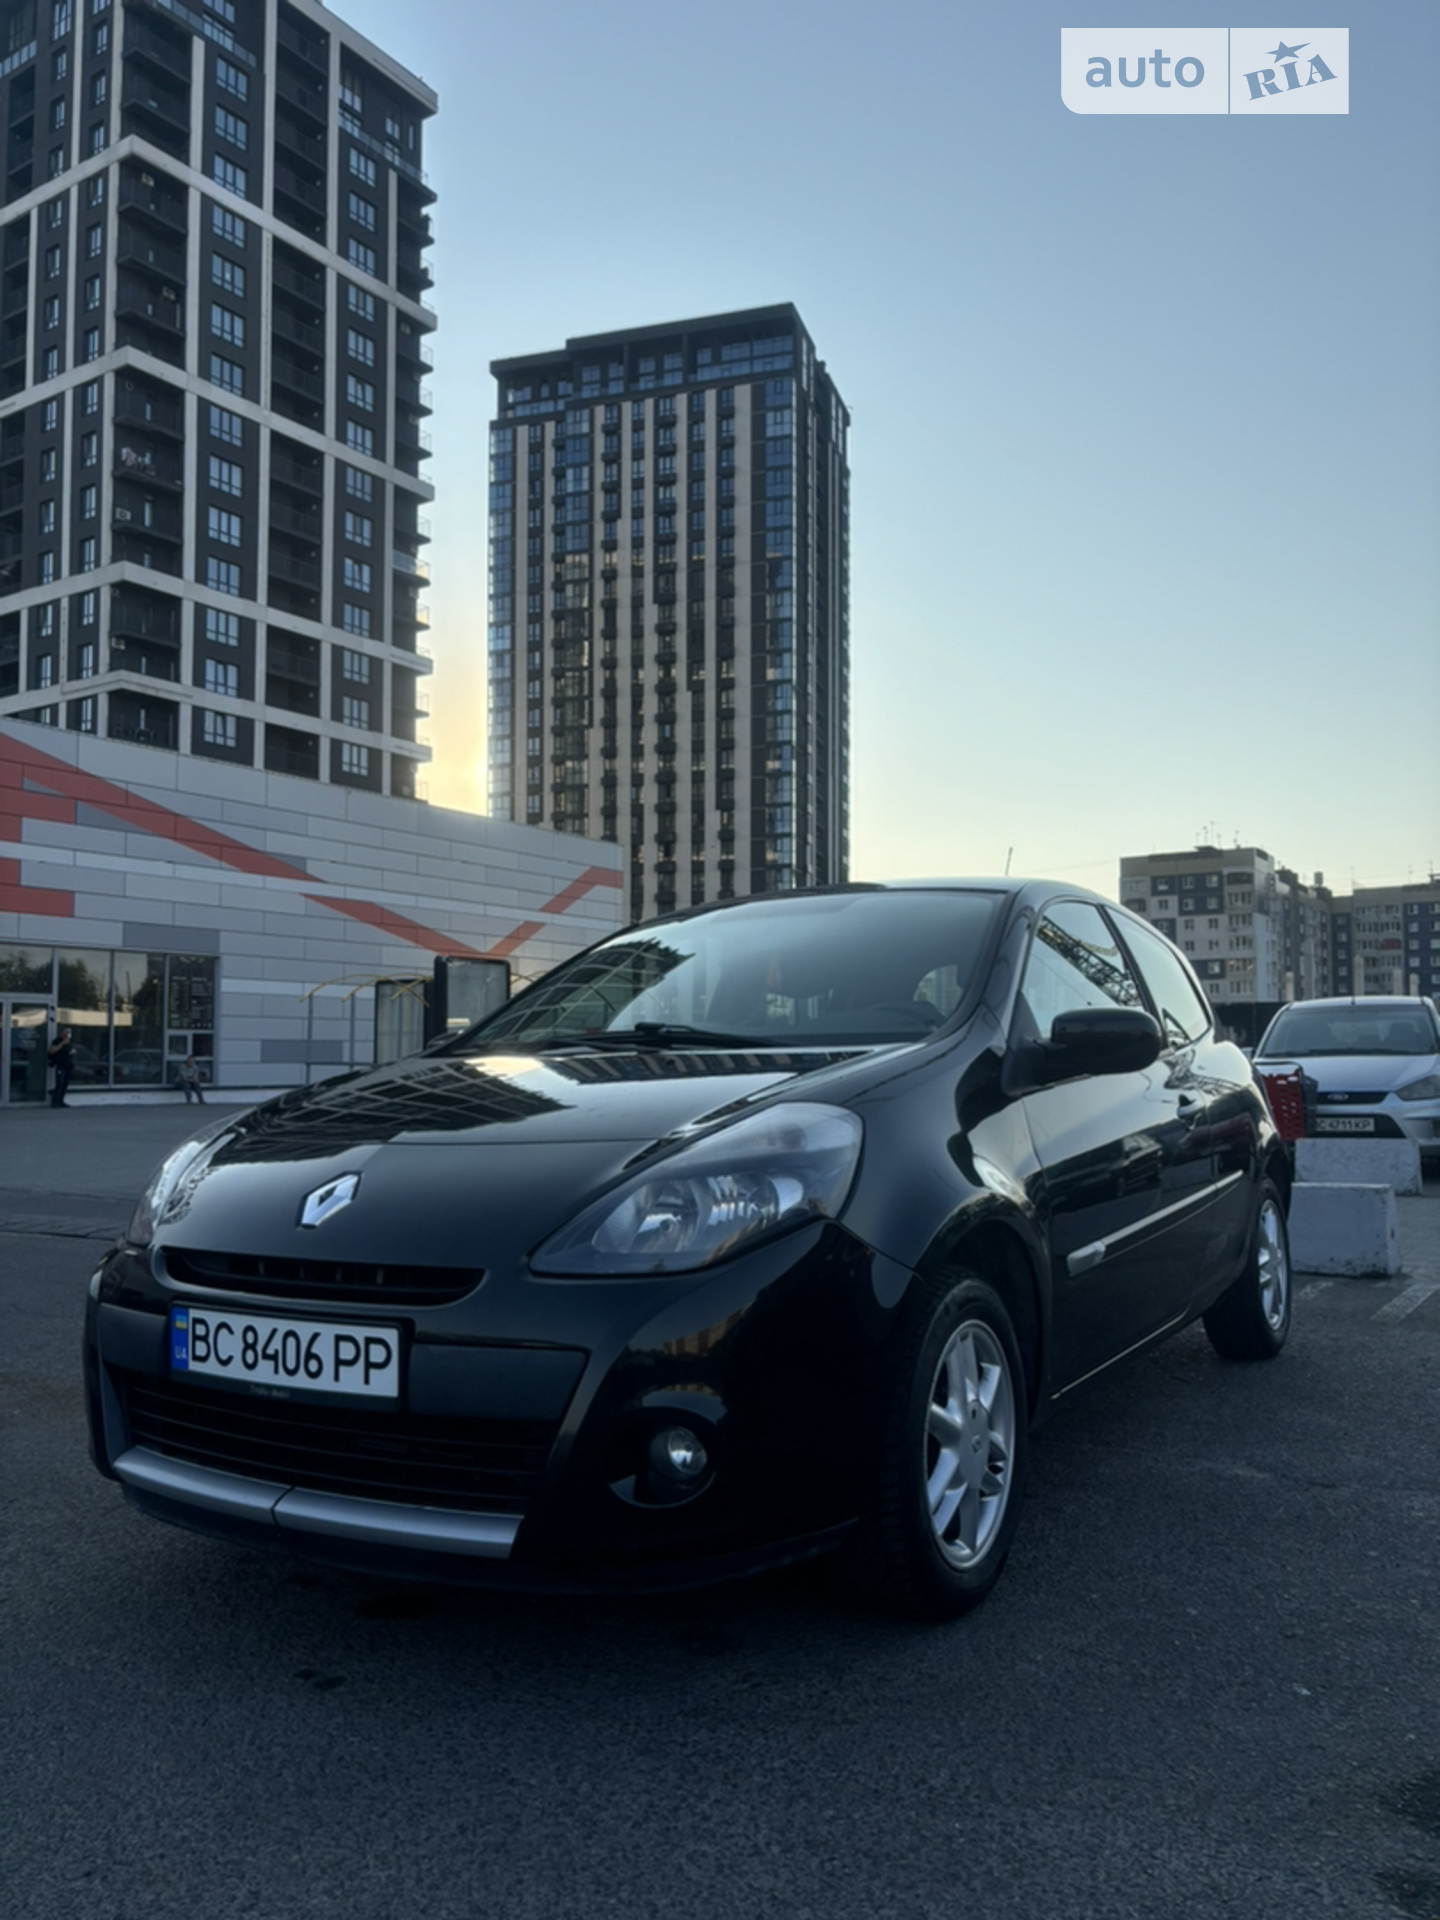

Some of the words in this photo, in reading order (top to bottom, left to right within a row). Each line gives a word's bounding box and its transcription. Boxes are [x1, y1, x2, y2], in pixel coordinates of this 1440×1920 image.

[174, 1346, 187, 1359] UA
[191, 1317, 235, 1367] BC
[241, 1324, 324, 1379] 8406
[333, 1333, 393, 1386] PP
